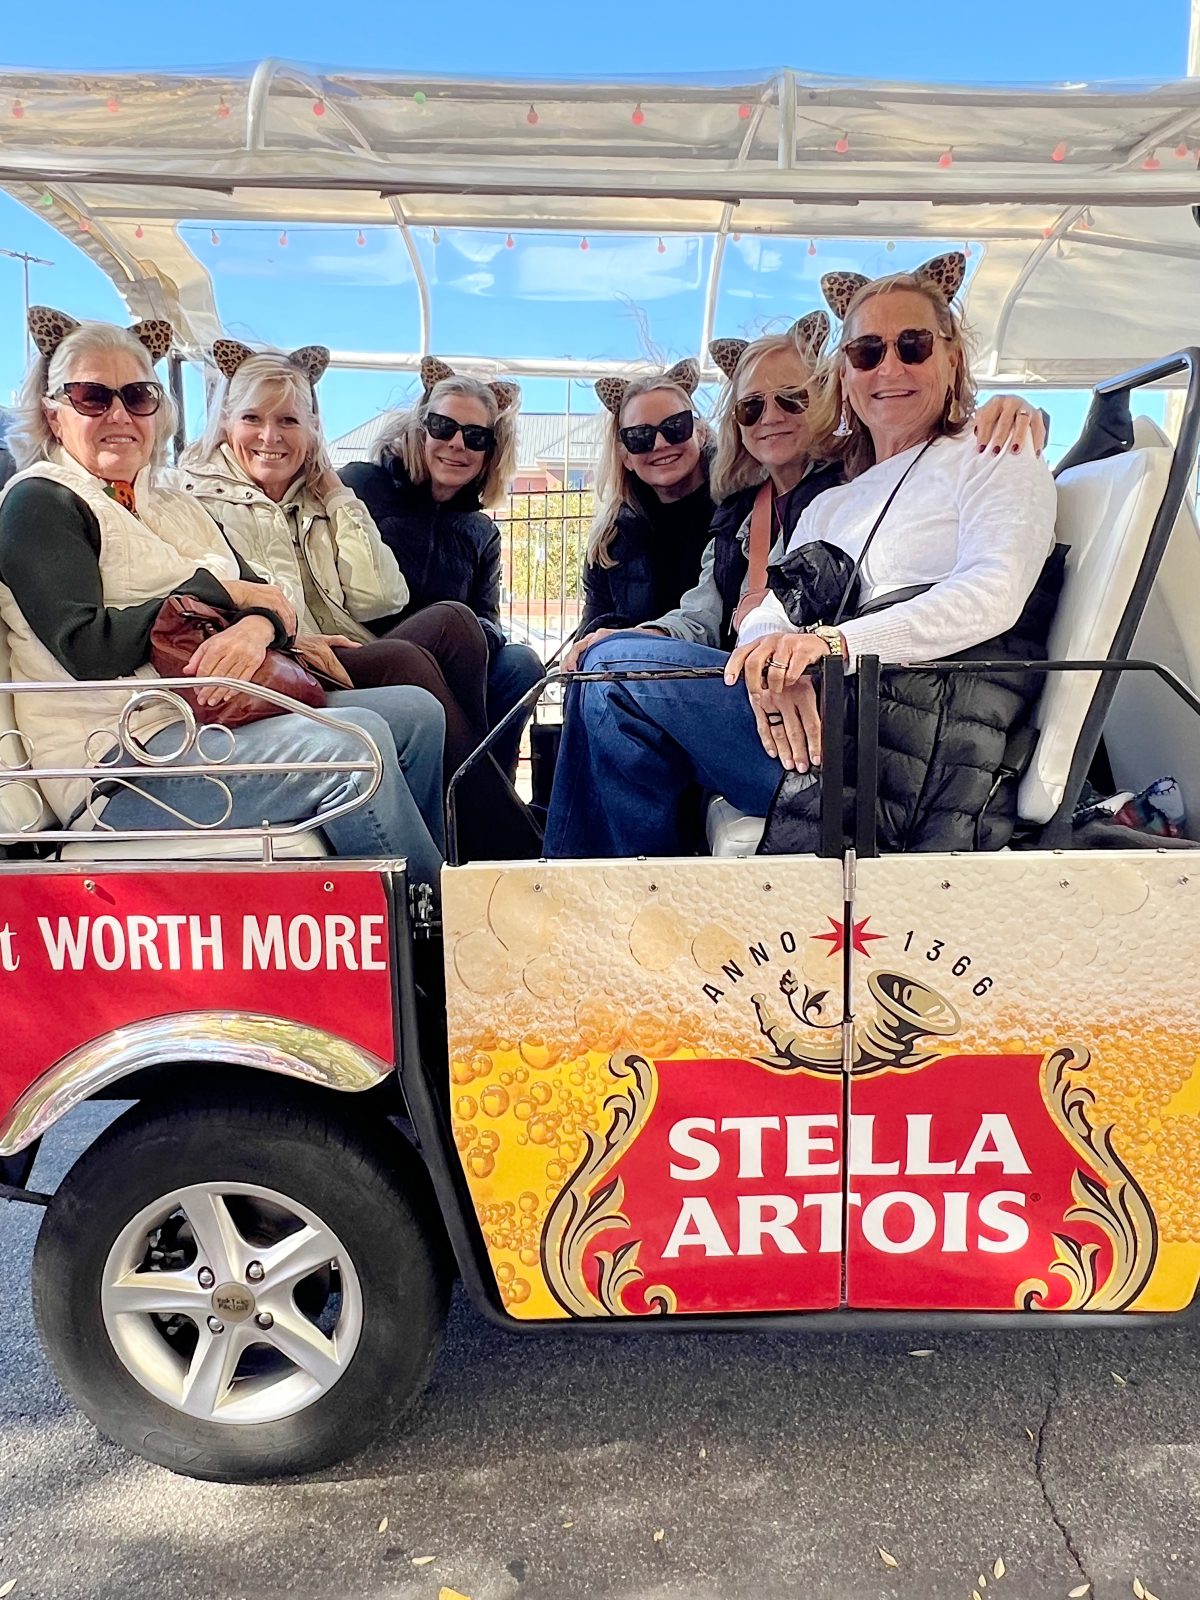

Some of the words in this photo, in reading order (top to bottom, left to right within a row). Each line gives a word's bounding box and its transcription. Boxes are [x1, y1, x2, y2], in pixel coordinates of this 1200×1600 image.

[37, 915, 224, 971] WORTH
[242, 915, 387, 971] MORE
[701, 931, 797, 1004] ANNO
[903, 930, 993, 998] 1366
[668, 1113, 1032, 1181] STELLA
[661, 1190, 1030, 1258] ARTOIS
